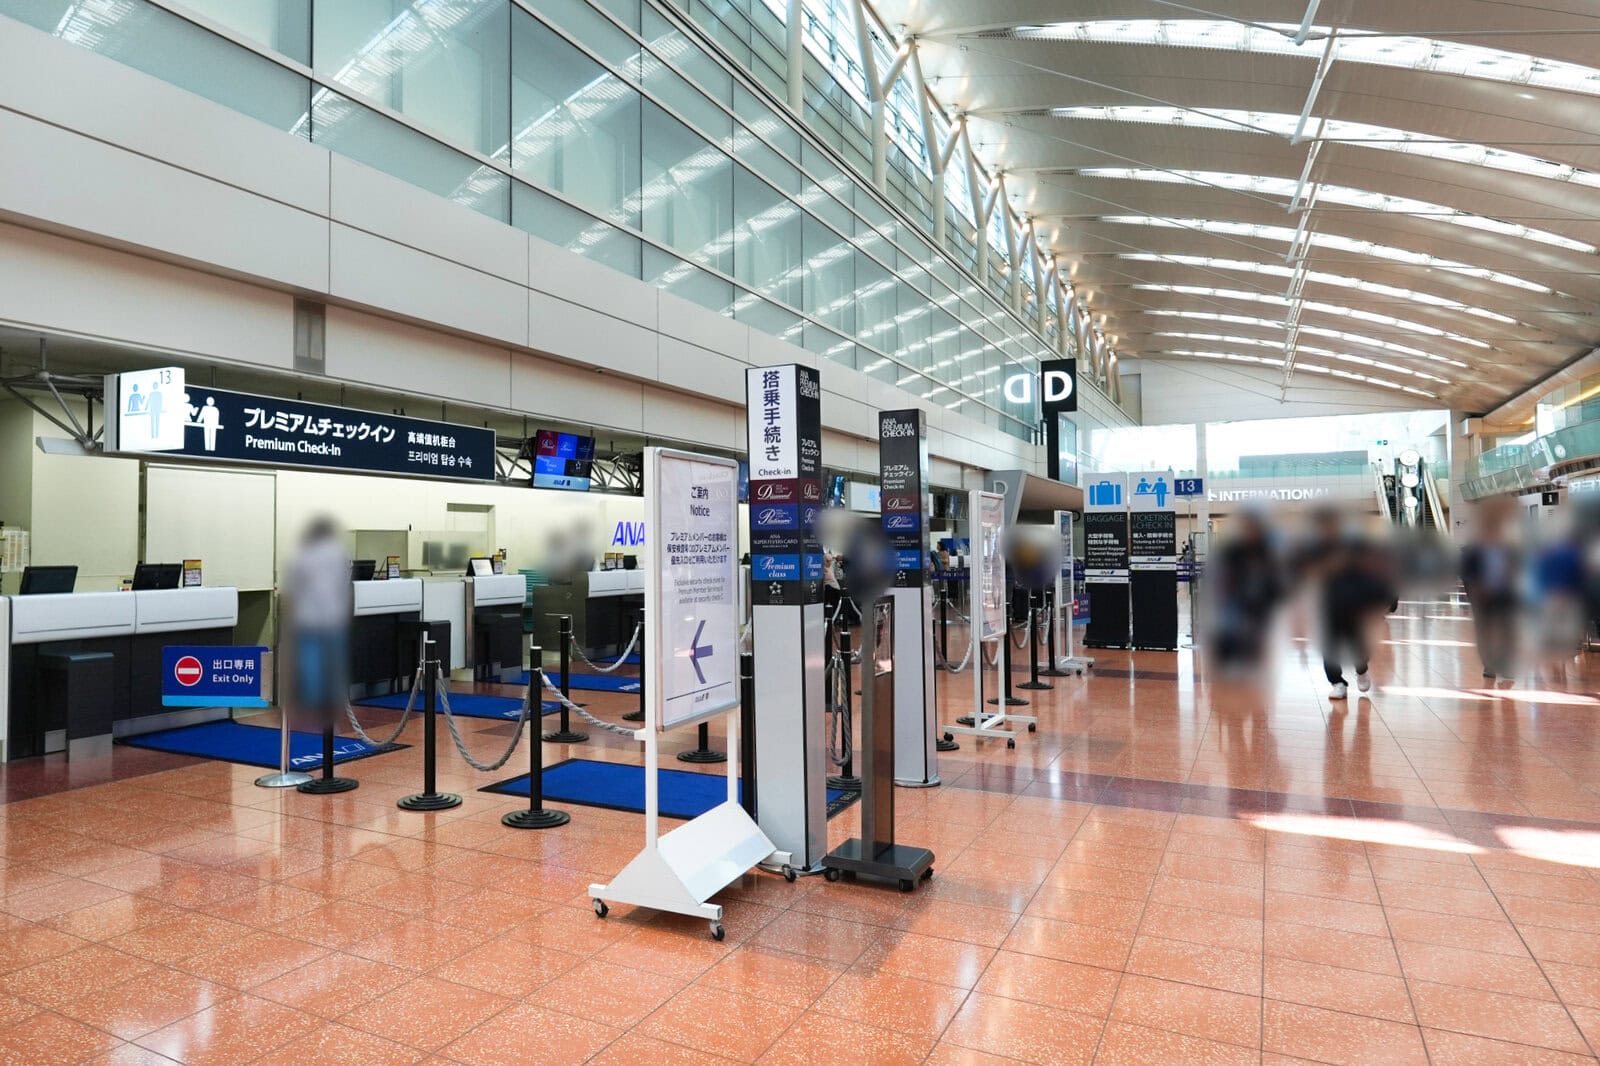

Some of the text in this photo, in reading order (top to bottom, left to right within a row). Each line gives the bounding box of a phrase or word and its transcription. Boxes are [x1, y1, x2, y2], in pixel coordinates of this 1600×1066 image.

[159, 370, 171, 384] 13
[1044, 371, 1073, 402] D
[762, 370, 781, 462] 搭乗手続き
[243, 407, 396, 443] プレミアムチェックイン
[245, 434, 341, 456] Premium Check-In
[407, 450, 473, 469] 프리미엄 탑승 수속
[758, 468, 792, 477] Check-in
[1180, 480, 1195, 492] 13
[690, 504, 711, 517] Notice
[612, 522, 645, 546] ANA
[760, 556, 796, 570] Premium
[769, 570, 787, 578] class
[212, 660, 254, 670] 出口専用
[212, 674, 254, 684] Exit Only
